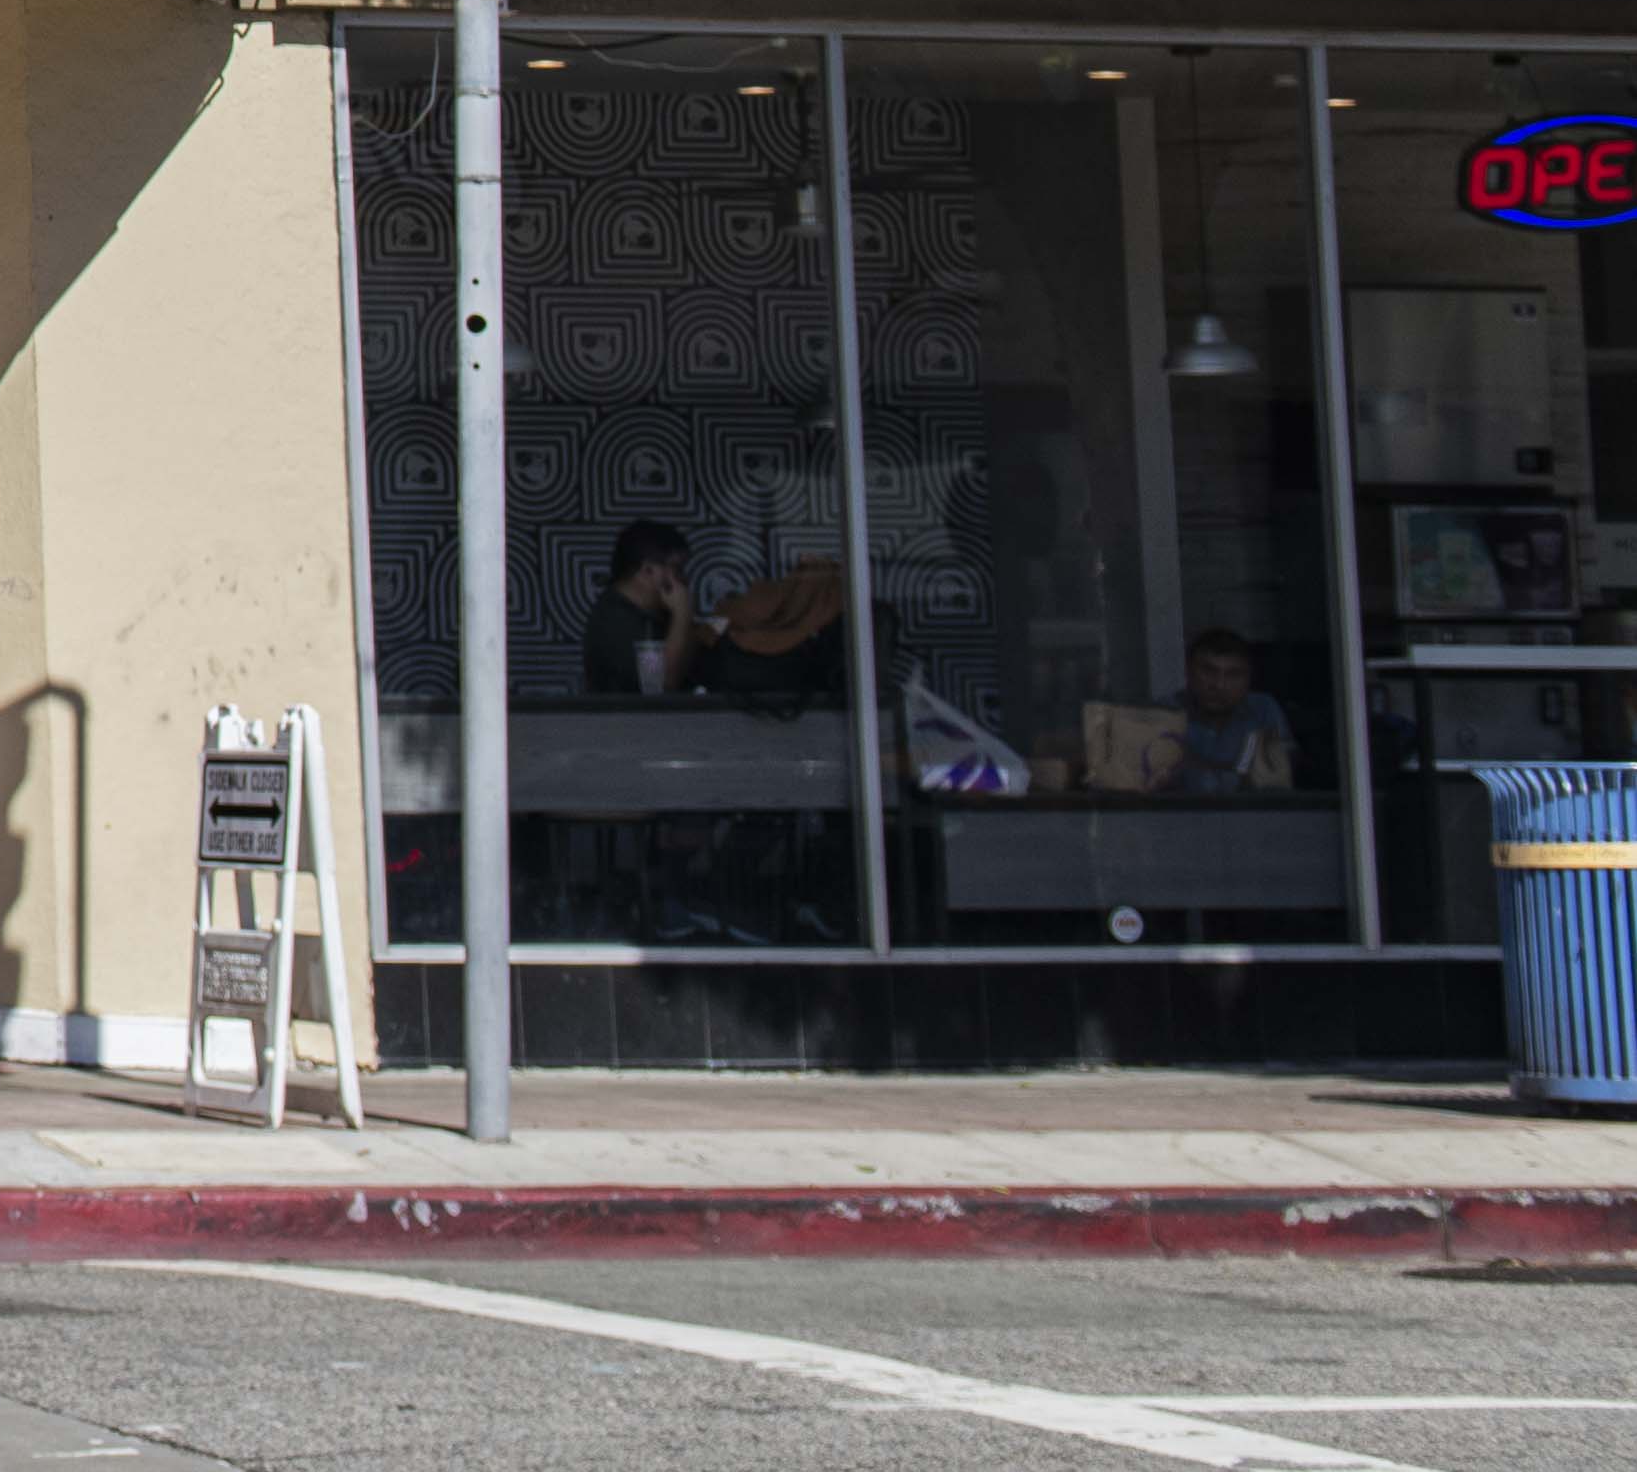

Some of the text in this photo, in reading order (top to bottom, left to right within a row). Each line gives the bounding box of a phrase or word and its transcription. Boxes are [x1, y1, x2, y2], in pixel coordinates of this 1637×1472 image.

[1468, 140, 1637, 208] OPE
[208, 769, 285, 794] SIDEWALK CLOSED
[226, 831, 255, 854] OTHER
[257, 832, 278, 855] SIDE
